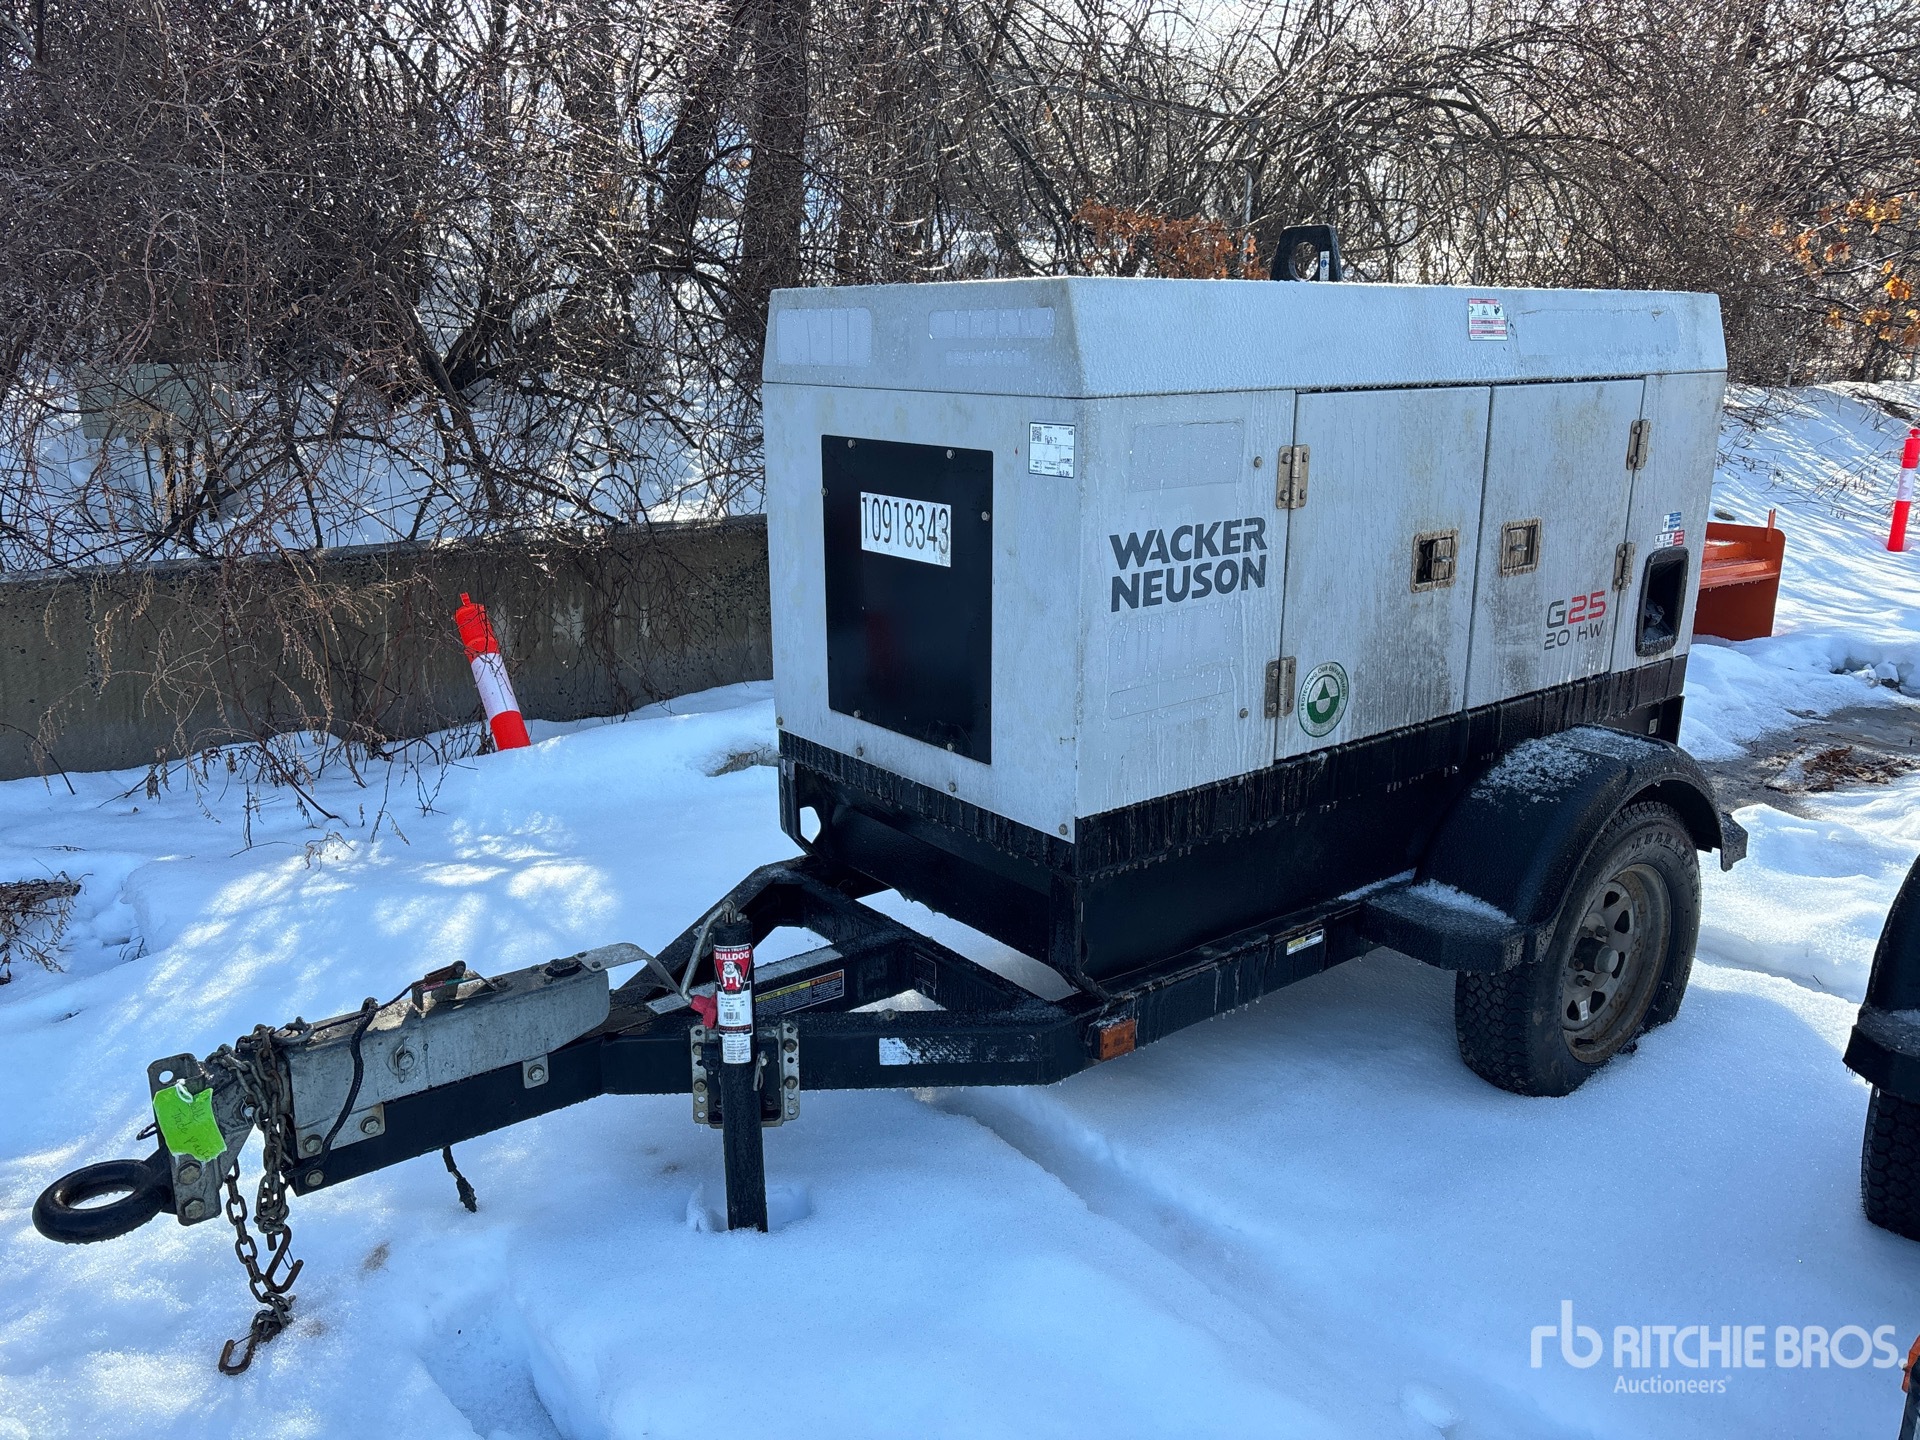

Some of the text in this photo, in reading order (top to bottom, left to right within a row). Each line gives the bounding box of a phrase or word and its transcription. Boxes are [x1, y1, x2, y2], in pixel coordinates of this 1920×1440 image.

[862, 496, 949, 555] 10918343
[1109, 516, 1268, 571] WACKER
[1111, 554, 1267, 613] NEUSON
[1546, 590, 1606, 629] G25
[1544, 620, 1604, 650] 20 HW
[715, 951, 750, 961] BULLDOG
